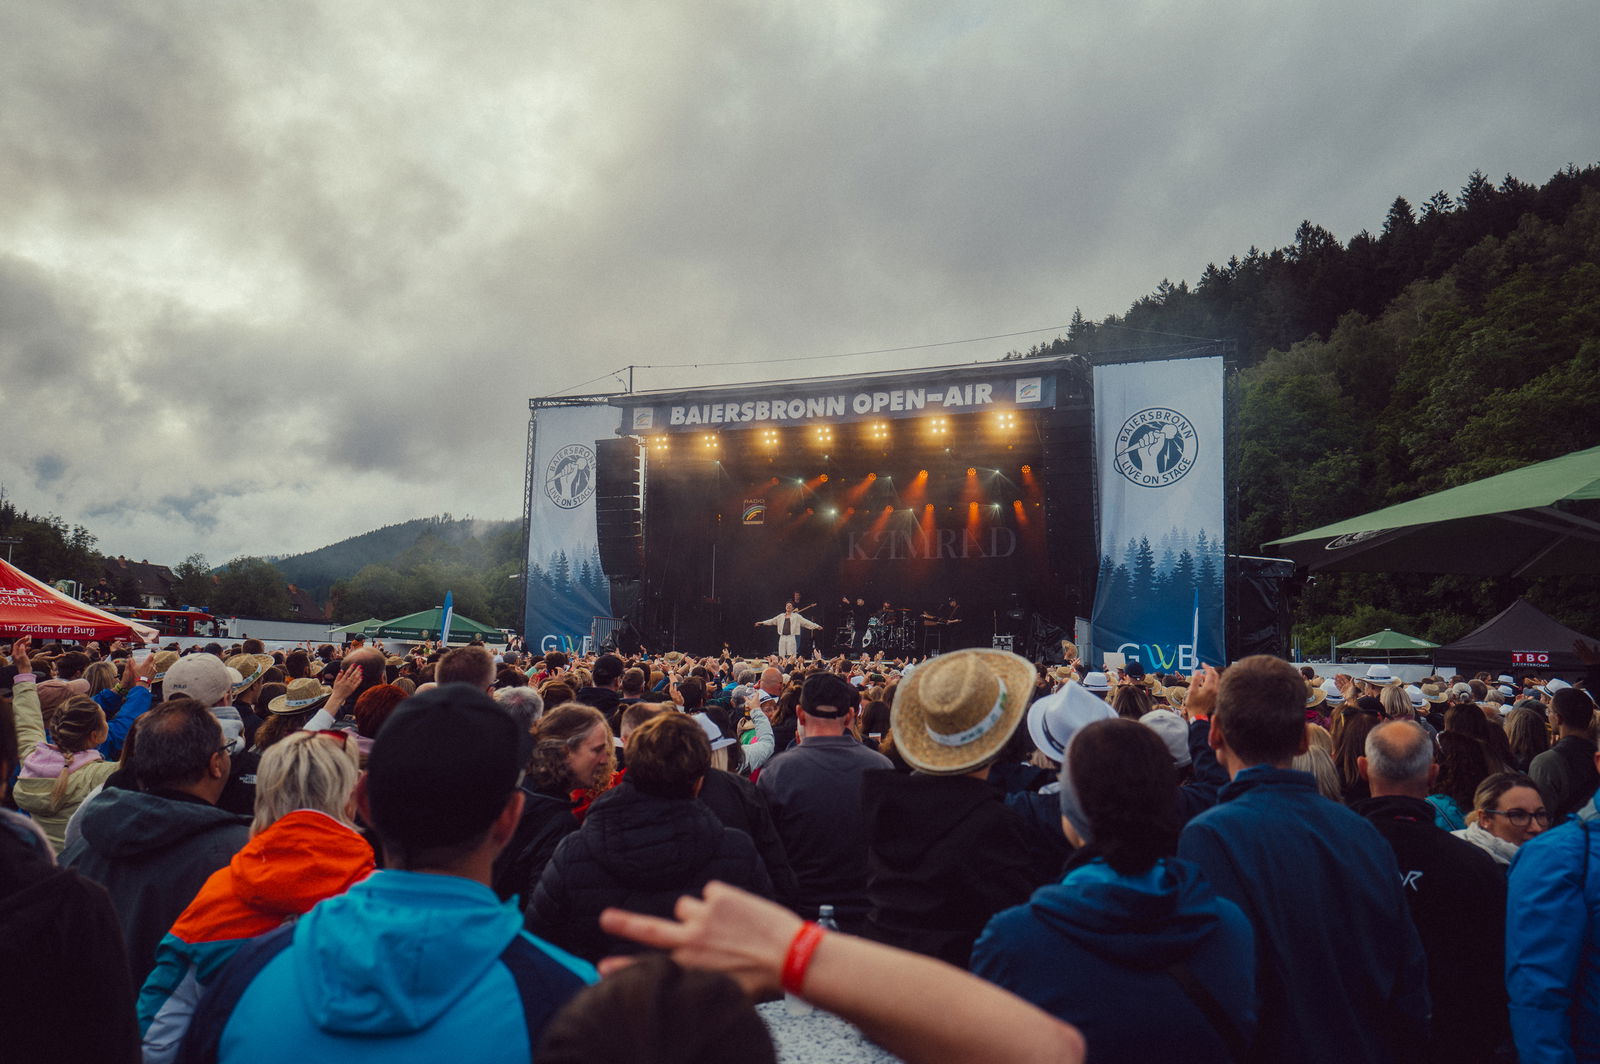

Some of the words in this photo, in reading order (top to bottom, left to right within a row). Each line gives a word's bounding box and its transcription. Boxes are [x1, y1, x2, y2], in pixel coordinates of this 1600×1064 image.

[670, 395, 846, 425] BAIERSBRONN
[852, 383, 993, 415] OPEN-AIR
[1120, 410, 1194, 442] BAIERSBRONN
[549, 446, 596, 472] BAIERSBRONN
[1121, 460, 1142, 480] LIVE
[1142, 474, 1159, 484] ON
[1161, 457, 1191, 483] STAGE
[549, 487, 561, 503] LIVE
[561, 498, 572, 507] ON
[846, 526, 1017, 561] KAMRAD
[20, 624, 54, 633] Zeichen
[57, 625, 71, 634] der
[74, 626, 95, 636] Burg
[1117, 643, 1199, 670] GWB
[1513, 653, 1549, 662] TBO
